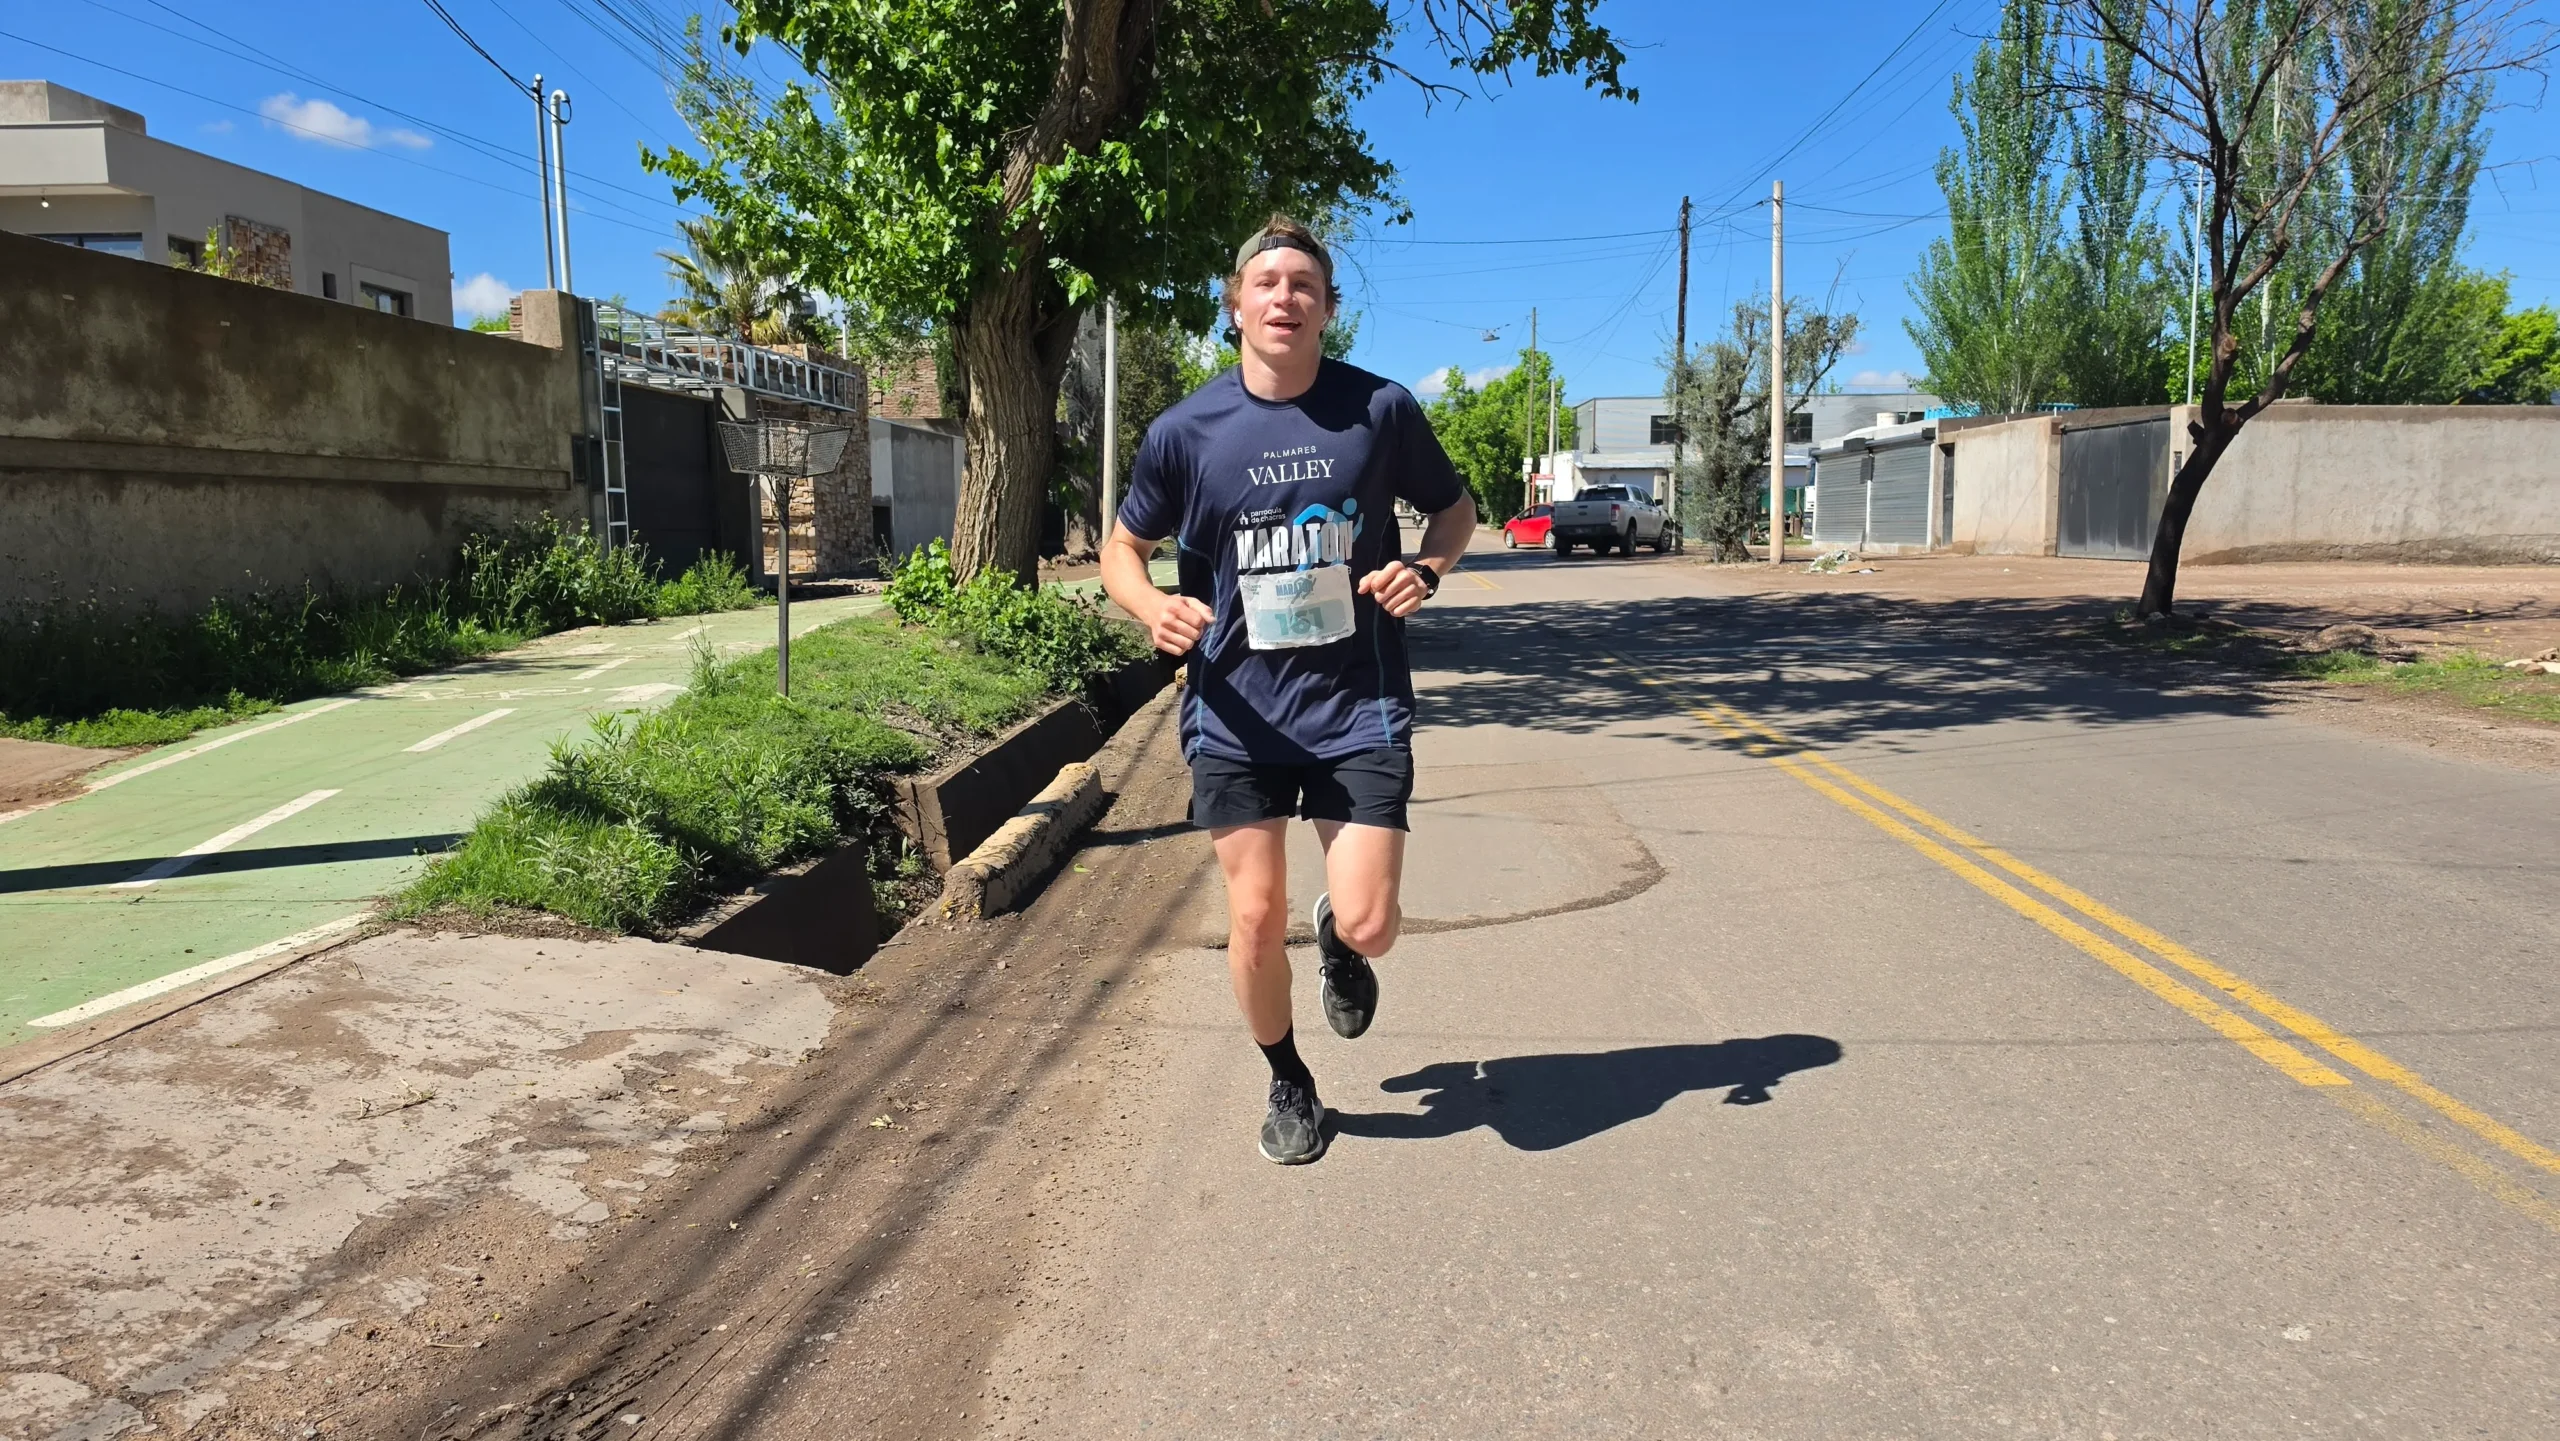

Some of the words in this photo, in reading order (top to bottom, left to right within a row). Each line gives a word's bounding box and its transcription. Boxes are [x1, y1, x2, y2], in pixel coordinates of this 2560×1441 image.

[1263, 445, 1317, 459] PALMARES
[1247, 459, 1335, 486] VALLEY
[1250, 507, 1282, 518] parroquia
[1251, 516, 1260, 524] de
[1260, 513, 1287, 523] chacras
[1234, 512, 1354, 570] MARATÓN
